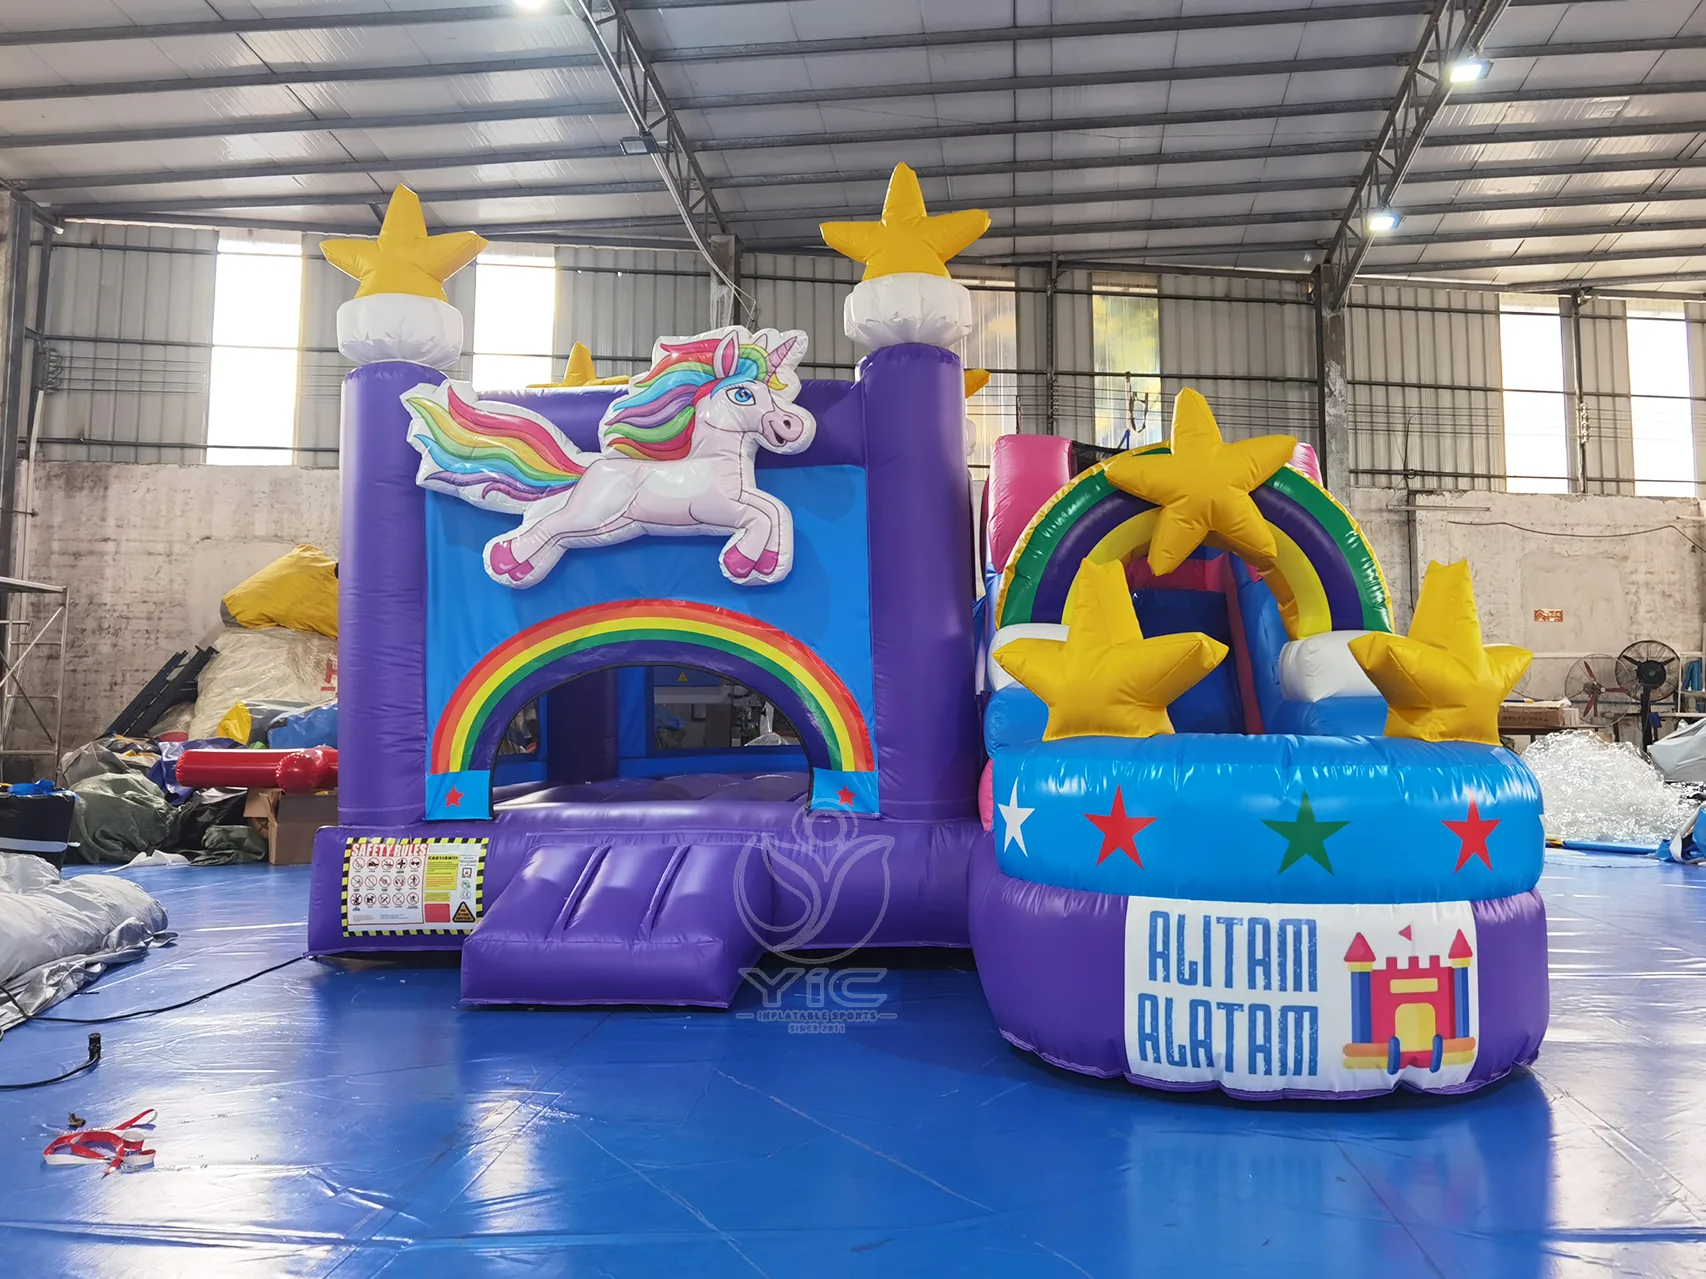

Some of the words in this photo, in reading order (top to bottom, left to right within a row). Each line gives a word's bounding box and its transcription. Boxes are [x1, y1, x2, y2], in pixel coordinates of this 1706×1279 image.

[351, 843, 395, 856] SAFETY
[394, 843, 427, 856] RULES
[1148, 911, 1318, 992] ALITAM
[1137, 993, 1319, 1076] ALATAM
